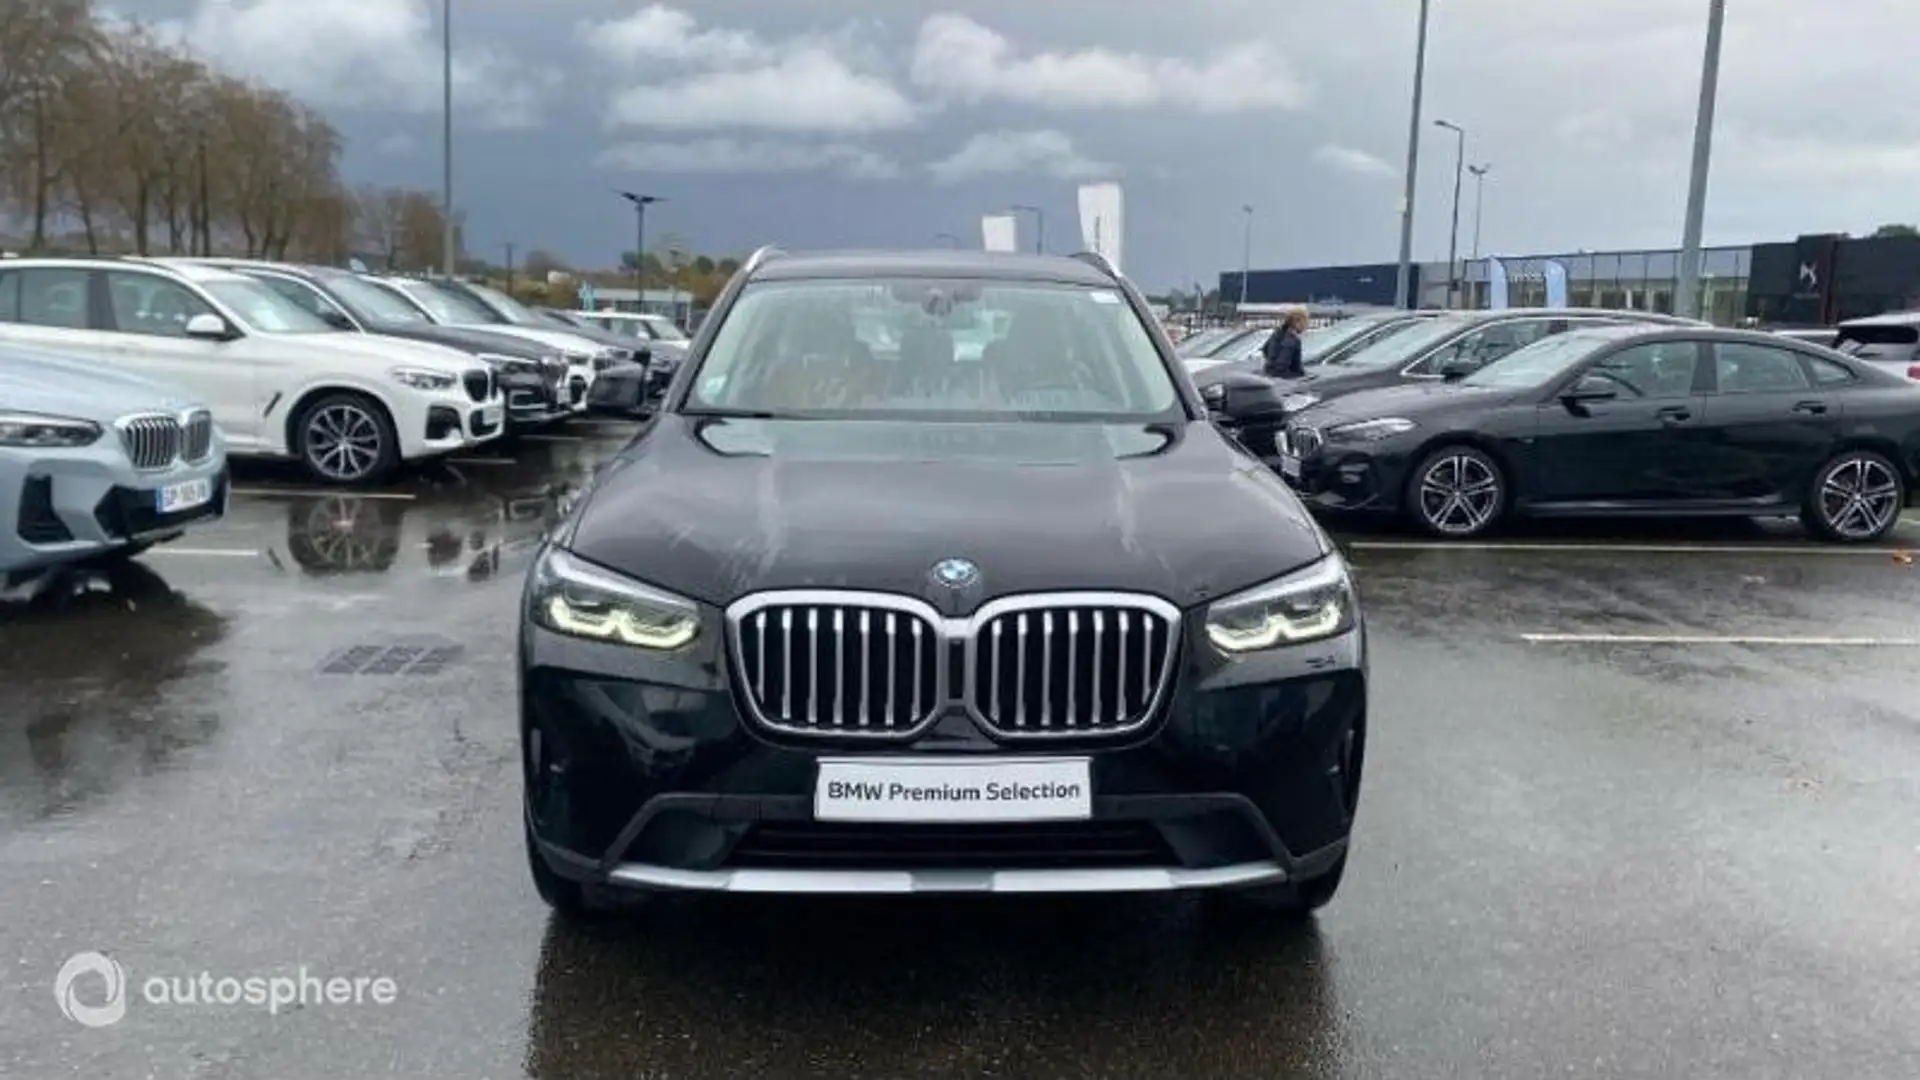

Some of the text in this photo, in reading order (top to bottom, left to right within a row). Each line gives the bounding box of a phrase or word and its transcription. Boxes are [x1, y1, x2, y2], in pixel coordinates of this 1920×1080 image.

[828, 781, 1080, 801] BMW Premium Selection
